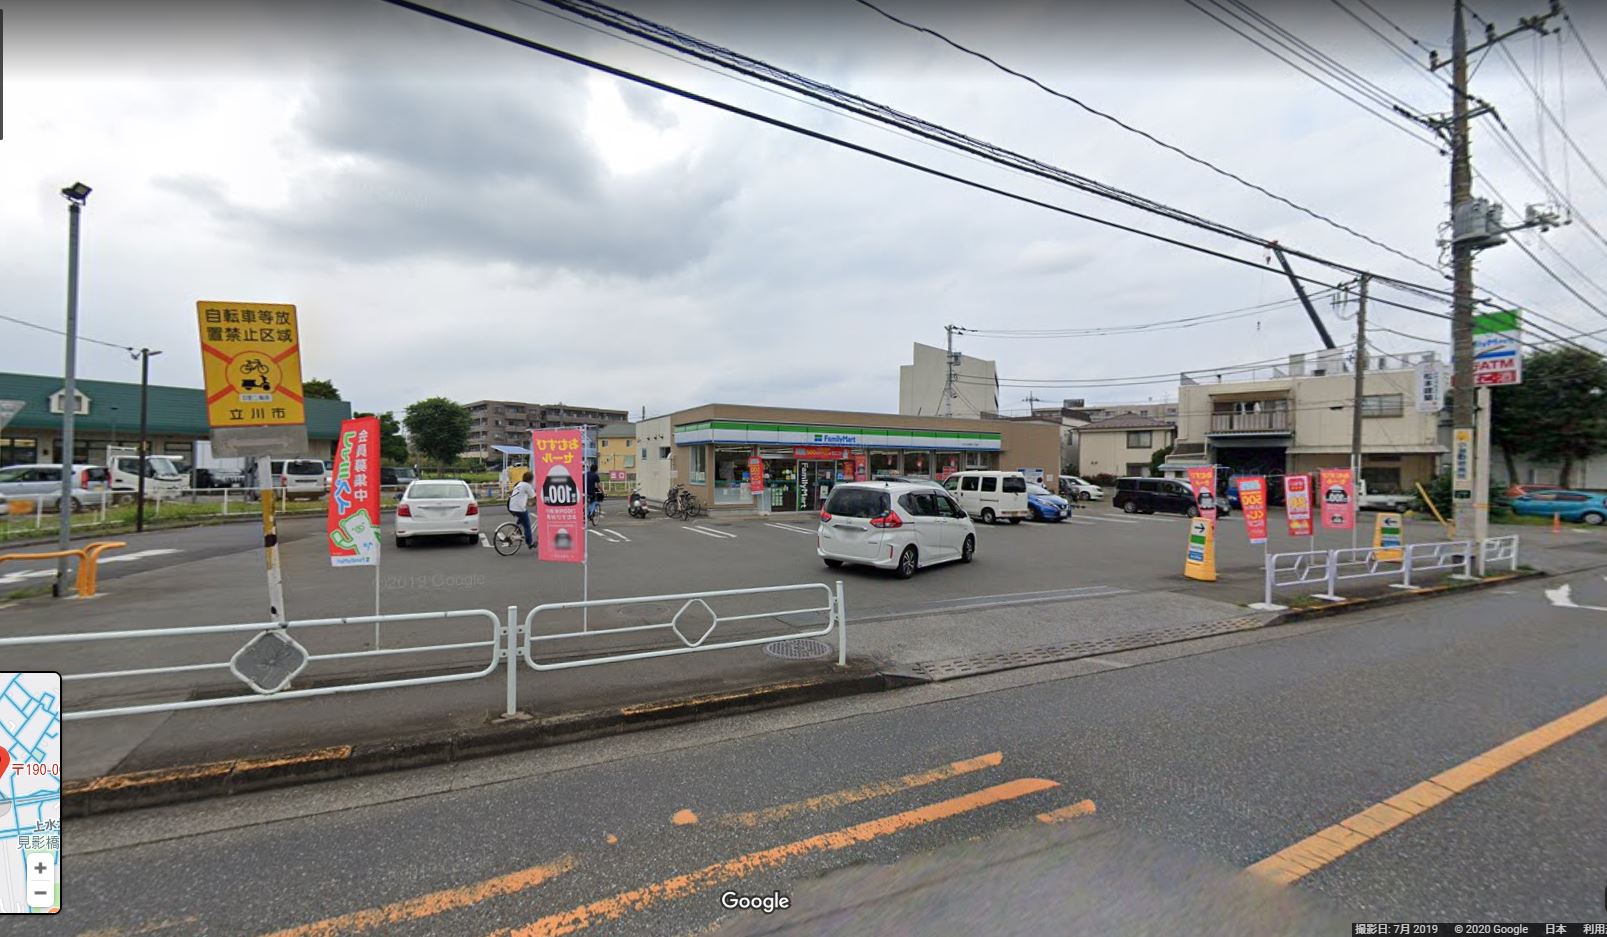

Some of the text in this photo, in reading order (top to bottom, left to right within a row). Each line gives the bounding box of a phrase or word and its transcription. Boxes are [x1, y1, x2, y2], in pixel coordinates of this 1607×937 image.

[205, 308, 291, 325] 自転車等放
[206, 327, 293, 342] 置禁止区域
[230, 407, 286, 420] 立川市
[800, 462, 808, 508] FamilyMart
